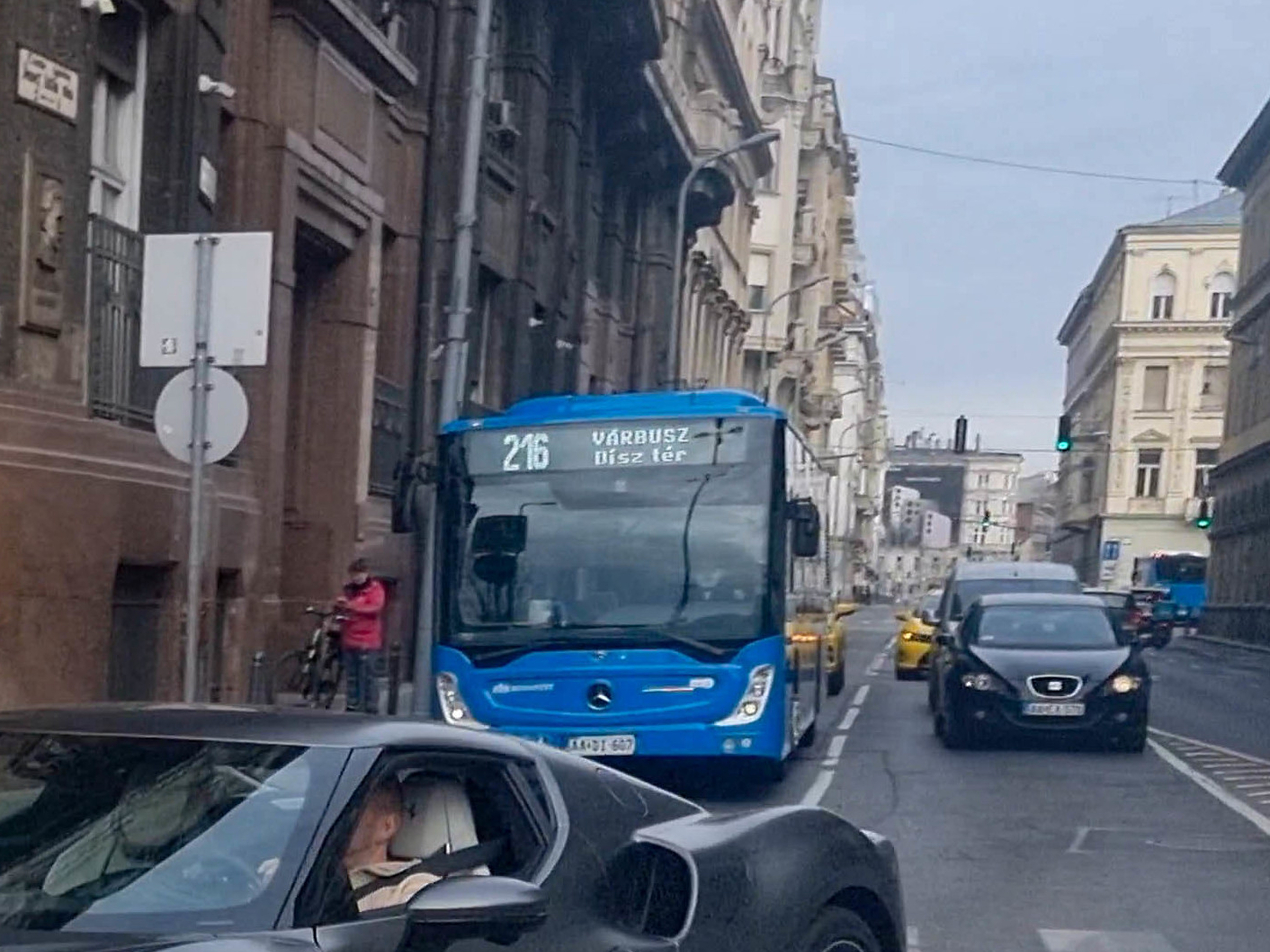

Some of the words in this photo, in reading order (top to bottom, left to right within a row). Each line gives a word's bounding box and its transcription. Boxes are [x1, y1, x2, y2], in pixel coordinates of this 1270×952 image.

[592, 427, 690, 446] VÁRBUSZ
[503, 433, 549, 471] 216
[595, 449, 643, 466] Dísz
[651, 446, 687, 463] tér
